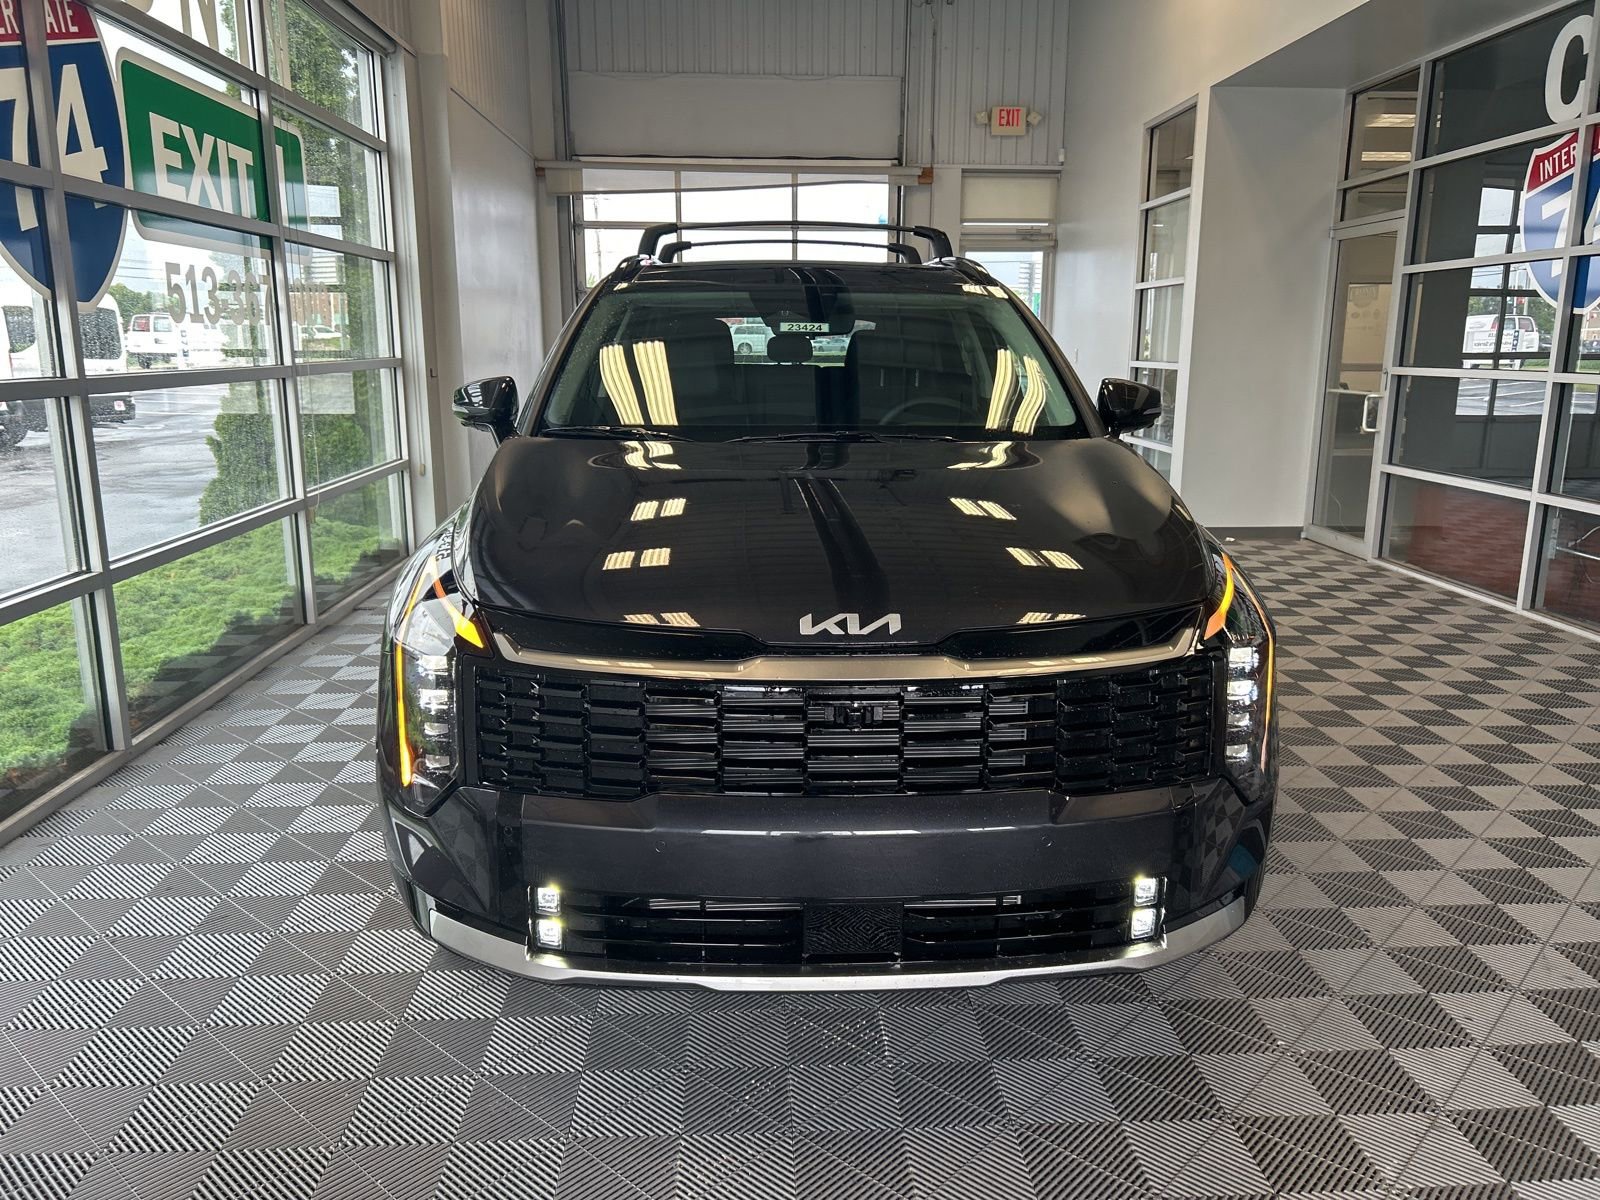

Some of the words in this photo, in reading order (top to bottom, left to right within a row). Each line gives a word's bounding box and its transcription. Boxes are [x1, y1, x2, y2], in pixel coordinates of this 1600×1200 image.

[998, 108, 1022, 127] EXIT
[149, 111, 254, 219] EXIT
[787, 323, 823, 332] 23424
